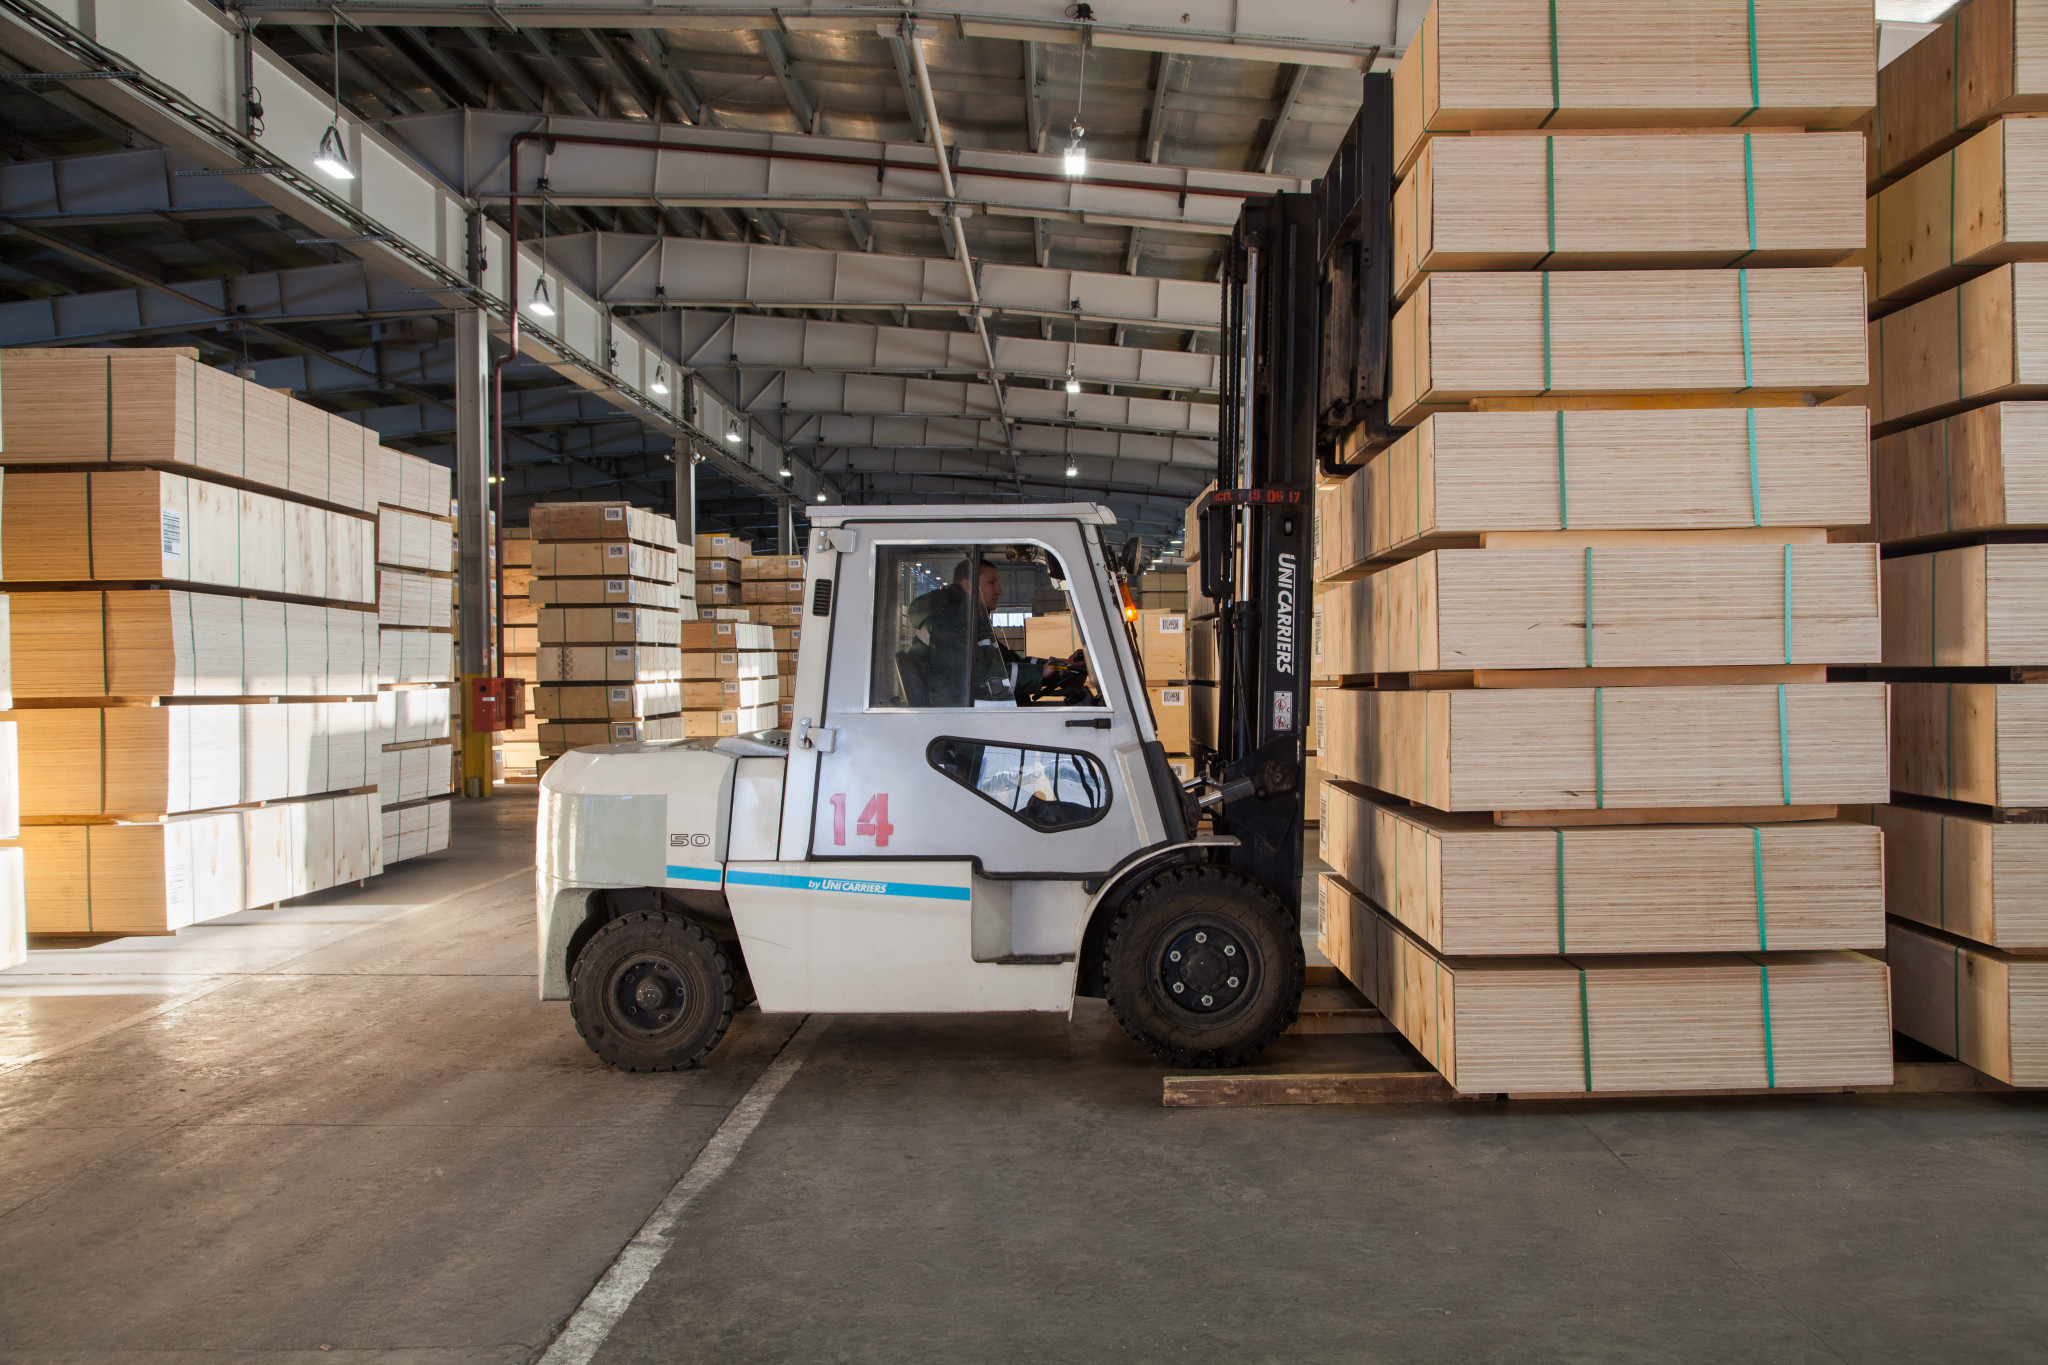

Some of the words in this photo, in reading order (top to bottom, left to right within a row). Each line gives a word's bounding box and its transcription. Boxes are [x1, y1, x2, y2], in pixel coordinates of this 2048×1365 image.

[1248, 489, 1261, 501] 19
[1289, 491, 1300, 503] 17
[829, 793, 894, 847] 14
[670, 833, 711, 847] 50
[808, 880, 821, 889] by
